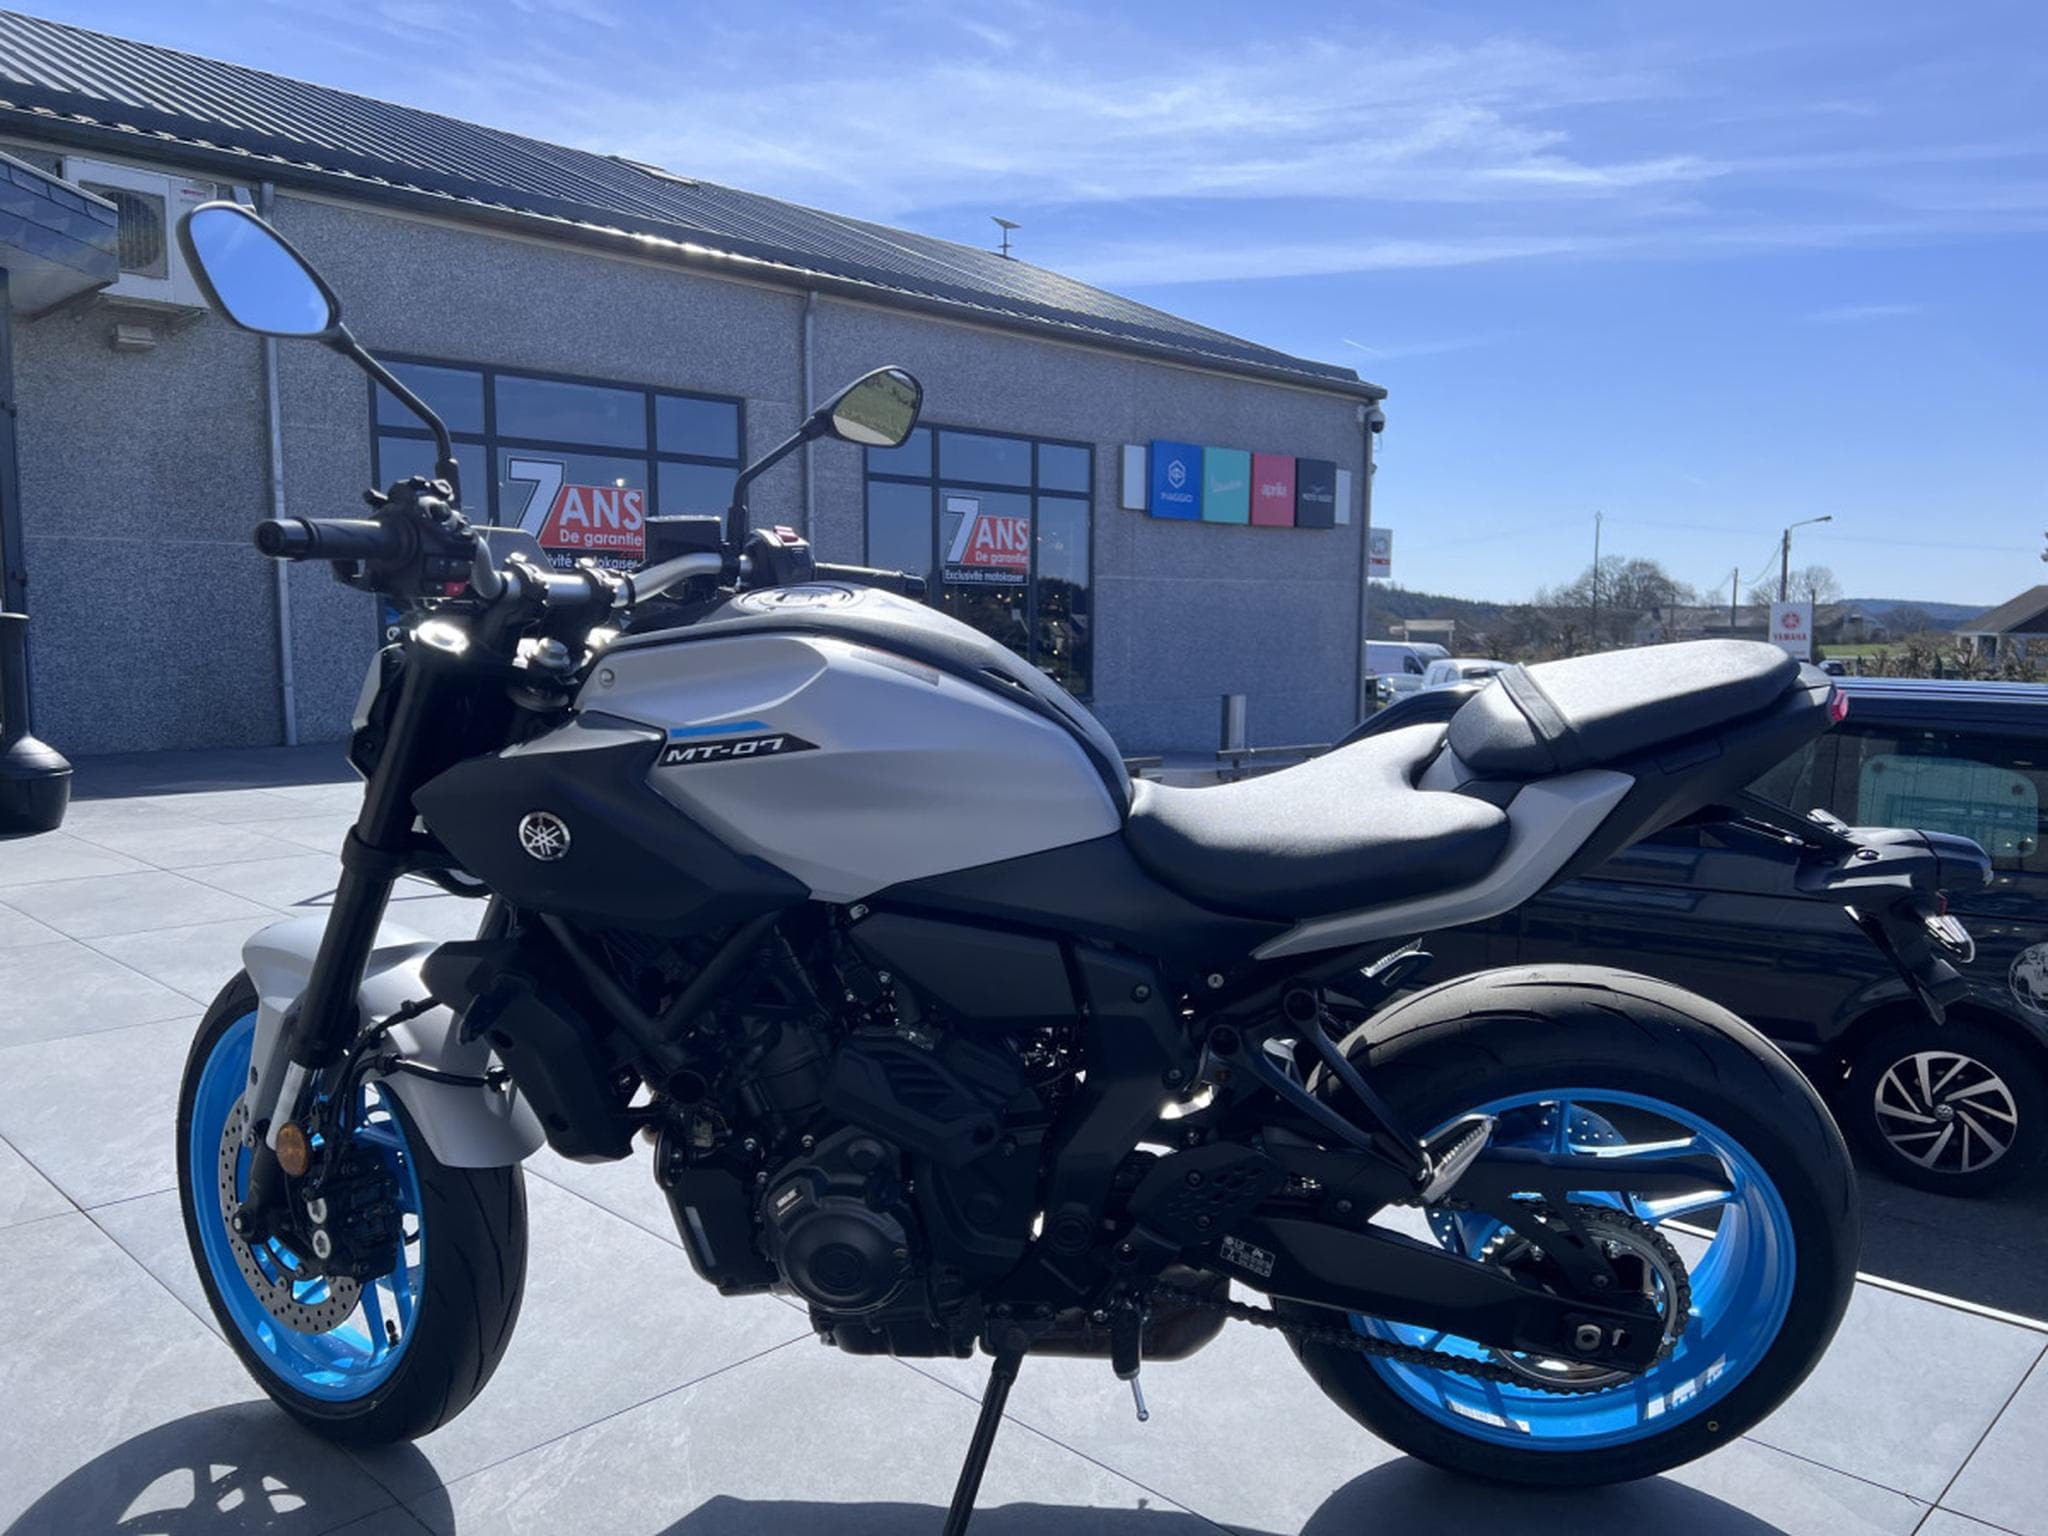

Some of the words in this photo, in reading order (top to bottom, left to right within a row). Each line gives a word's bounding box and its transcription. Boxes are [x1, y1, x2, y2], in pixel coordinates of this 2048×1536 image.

[508, 456, 566, 541] 7
[559, 487, 643, 531] ANS
[560, 528, 580, 543] De
[584, 532, 643, 548] garantie
[944, 496, 980, 563] 7
[974, 518, 1028, 552] ANS
[975, 551, 989, 562] De
[666, 736, 785, 763] MT-07
